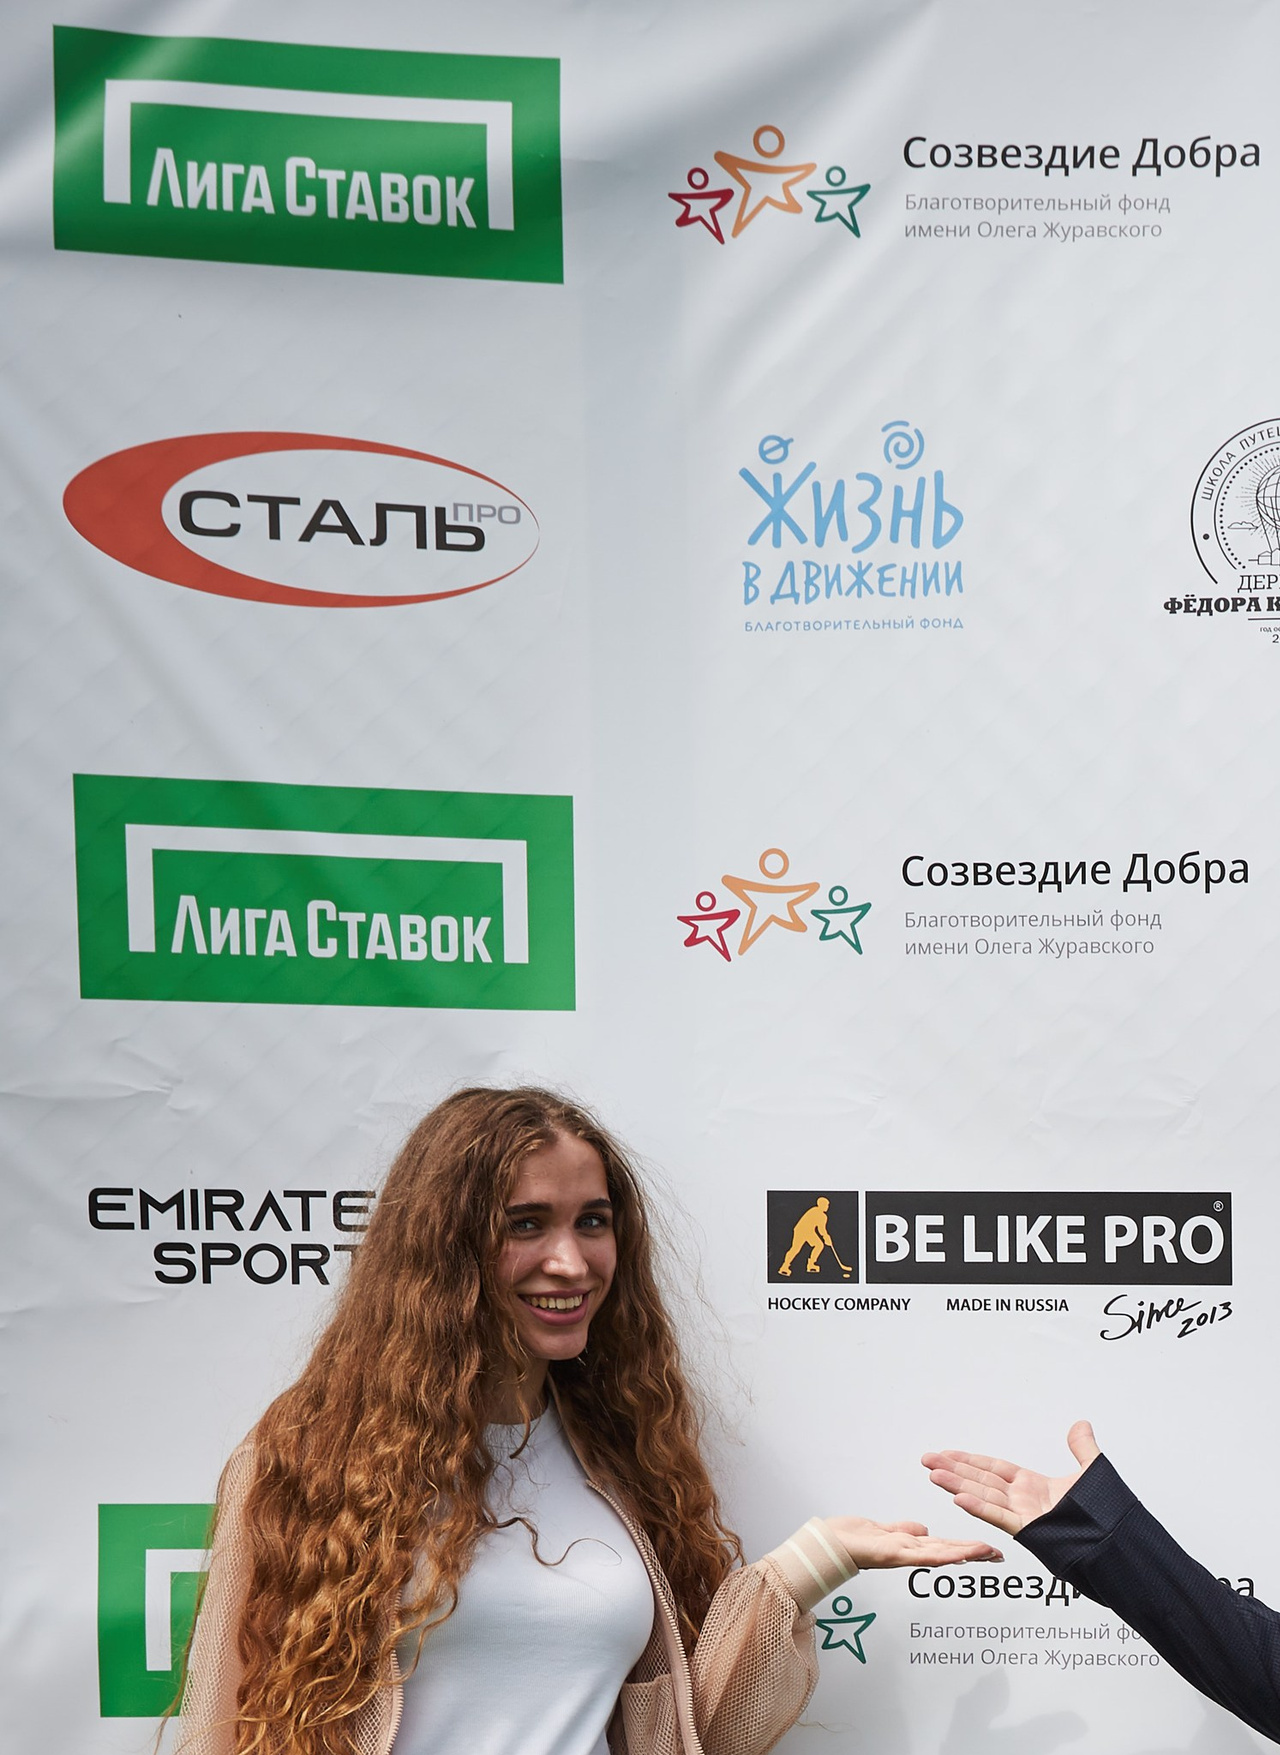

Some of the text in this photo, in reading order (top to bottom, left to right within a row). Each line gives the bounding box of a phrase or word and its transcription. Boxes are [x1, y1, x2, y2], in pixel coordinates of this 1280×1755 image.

[903, 135, 1260, 178] Созвездие Добра
[905, 193, 1171, 216] Благотворительный фонд
[904, 220, 1162, 243] имени Олега Журавского
[1200, 449, 1238, 502] ШКОЛА
[177, 488, 523, 554] СТАЛЬ ПРО
[769, 560, 964, 606] ДВИЖЕНИИ
[1162, 593, 1263, 617] ФЁДОРА
[744, 614, 965, 633] БЛАГОТВОРИТЕЛЬНЫЙ ФОНД
[901, 850, 1249, 894] Созвездие Добра
[905, 909, 1162, 933] Благотворительный фонд
[905, 937, 1154, 959] имени Олега Журавского
[87, 1186, 376, 1233] EMIRATE
[875, 1214, 946, 1263] BE
[963, 1214, 1087, 1263] LIKE
[768, 1297, 911, 1311] HOCKEY COMPANY
[946, 1298, 1070, 1312] MADE IN RUSSIA
[1099, 1293, 1234, 1341] Since 2013
[910, 1622, 1110, 1644] Благотворительный
[910, 1648, 1161, 1670] имени Олега Журавского
